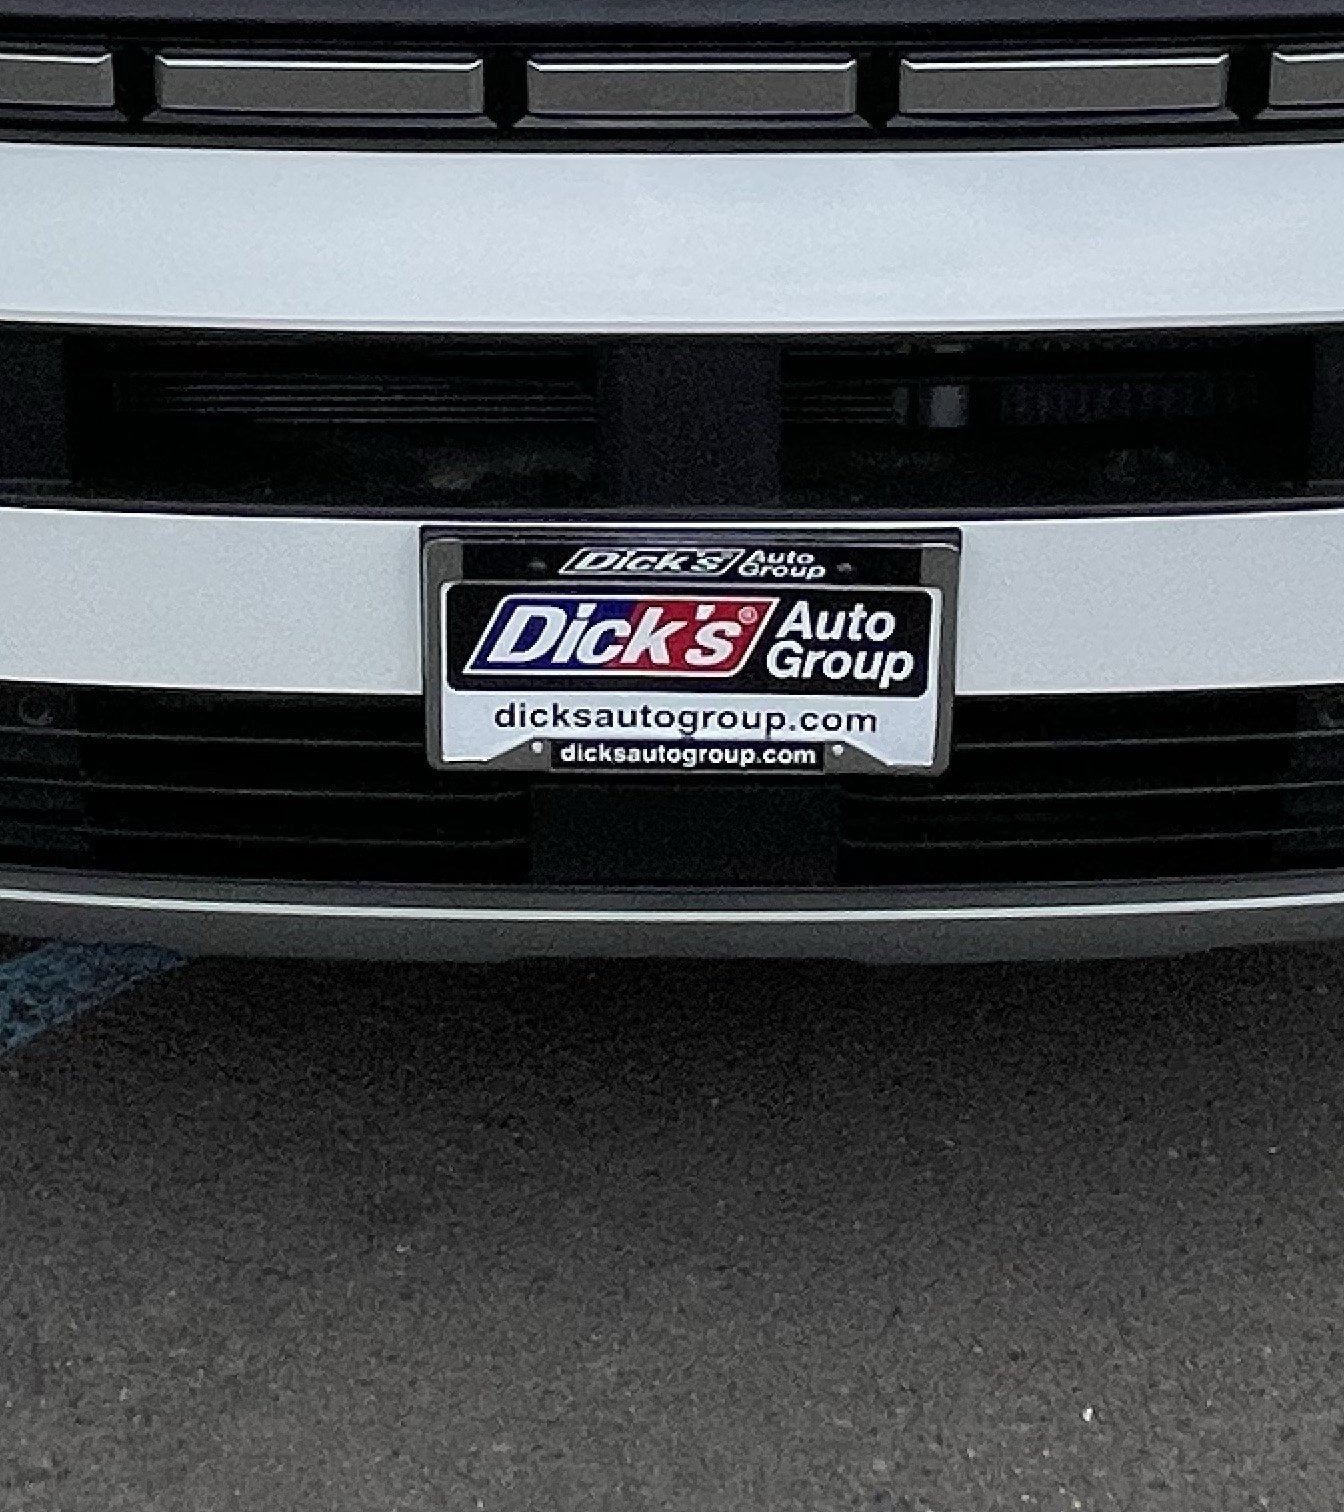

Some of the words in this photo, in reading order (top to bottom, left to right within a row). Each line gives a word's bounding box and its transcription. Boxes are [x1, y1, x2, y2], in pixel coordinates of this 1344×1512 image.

[739, 564, 826, 580] Group
[745, 549, 815, 565] Auto
[487, 601, 745, 667] Dick's
[776, 602, 896, 642] Auto
[767, 641, 915, 689] Group
[494, 702, 878, 737] dicksautogroup.com
[560, 743, 817, 768] dicksautogroup.com
